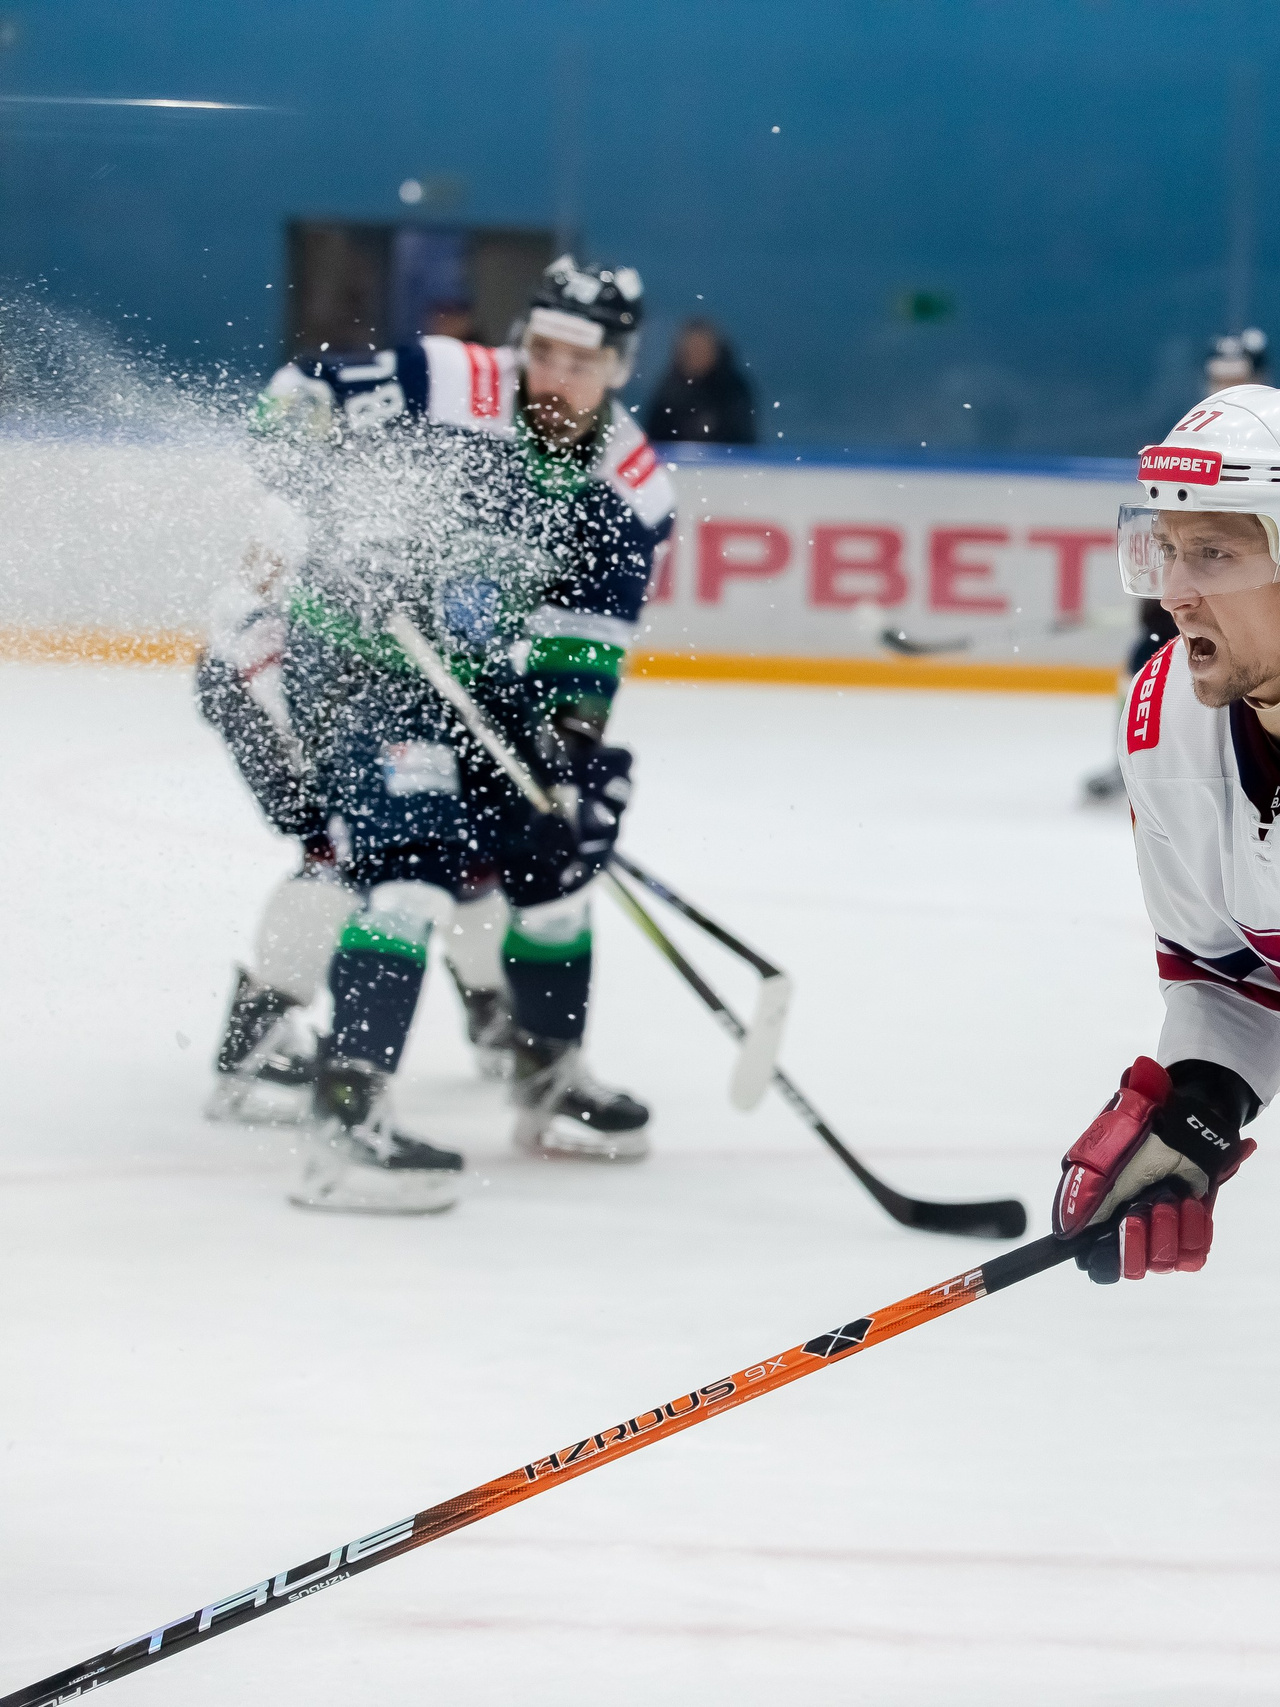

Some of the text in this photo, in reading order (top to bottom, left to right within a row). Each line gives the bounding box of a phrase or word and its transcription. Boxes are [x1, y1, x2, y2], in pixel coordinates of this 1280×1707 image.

[1175, 410, 1224, 433] 27
[1141, 455, 1217, 474] OLIMPBET
[652, 521, 1114, 624] PBET
[1134, 643, 1169, 741] PBET
[1186, 1114, 1231, 1151] CCM
[1066, 1166, 1086, 1215] CCM
[524, 1374, 737, 1484] HZRDUS
[744, 1355, 788, 1383] 9X
[112, 1513, 419, 1655] TRUE
